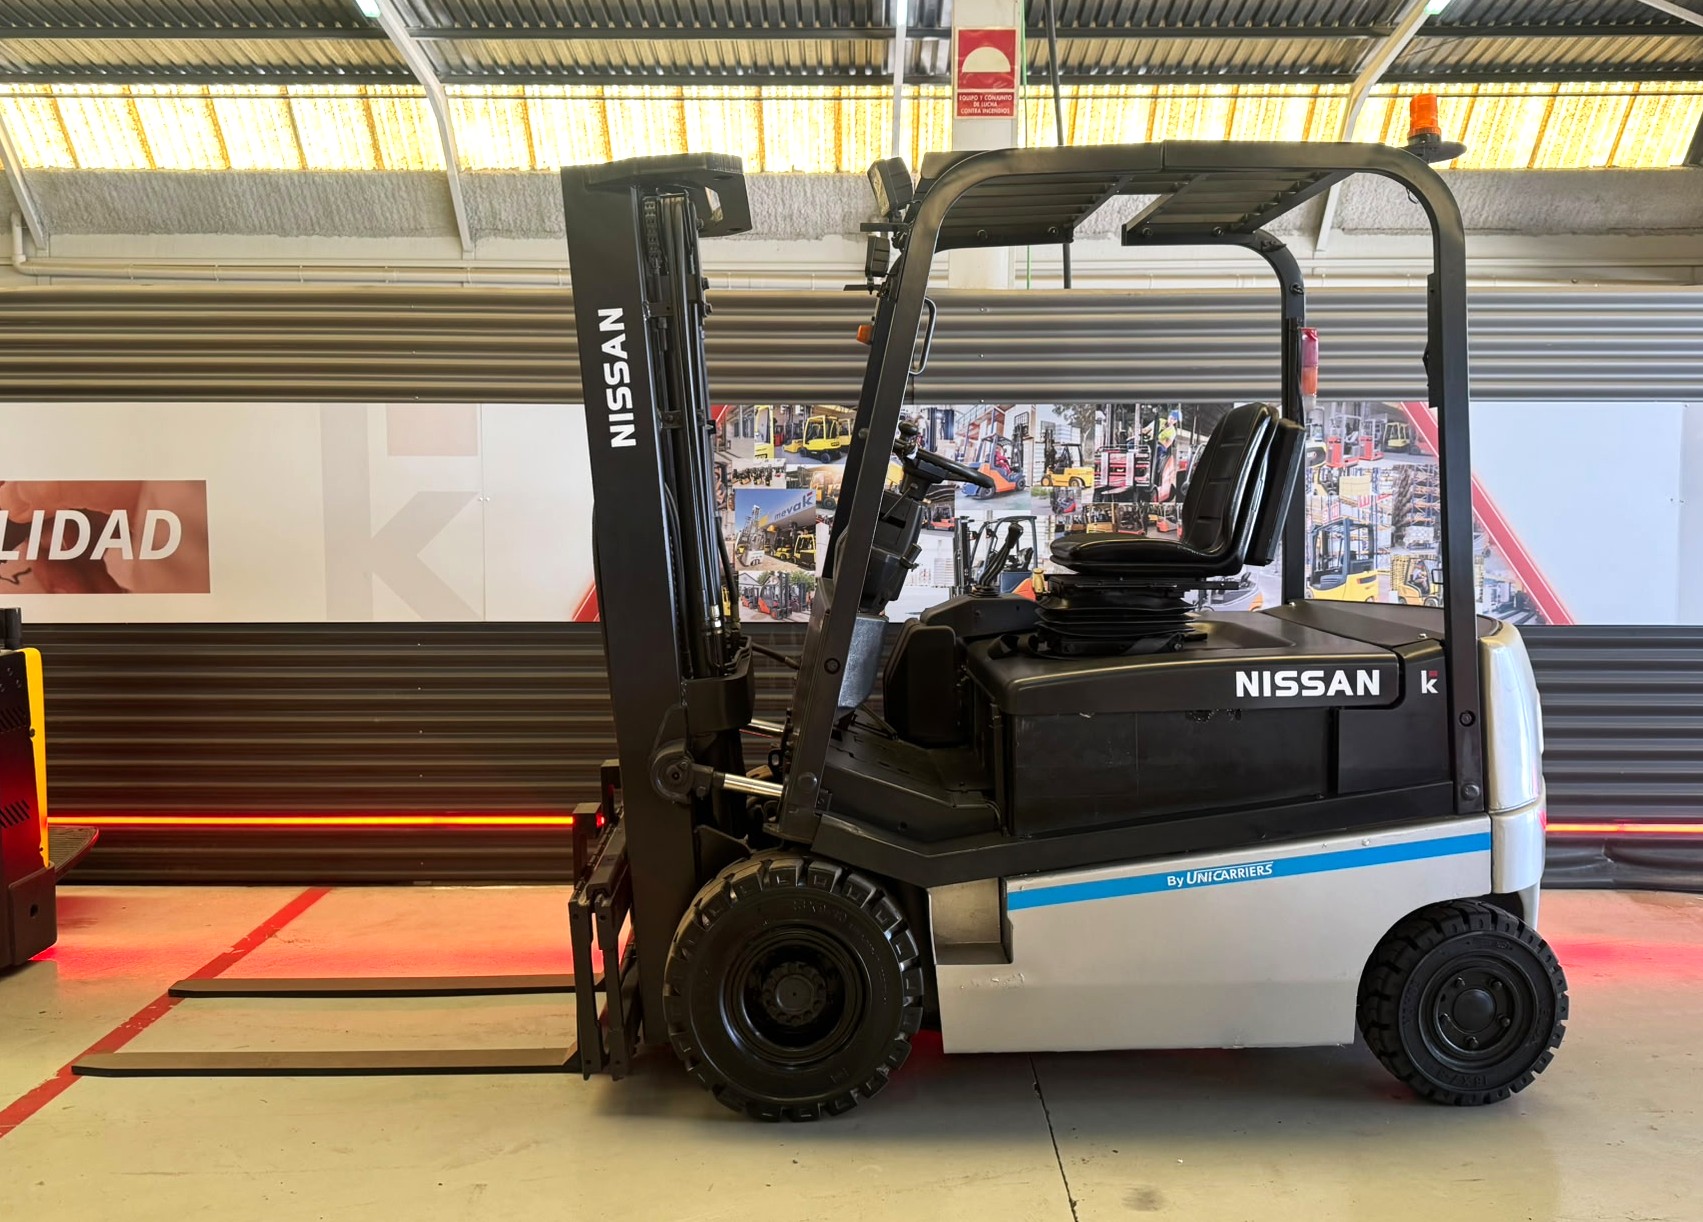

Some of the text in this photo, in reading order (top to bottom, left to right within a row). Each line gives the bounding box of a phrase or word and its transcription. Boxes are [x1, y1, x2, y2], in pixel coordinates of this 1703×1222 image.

[597, 307, 637, 448] NISSAN
[774, 492, 813, 520] mevak
[1235, 669, 1380, 698] NISSAN
[1167, 861, 1274, 888] By UNICARRIERS
